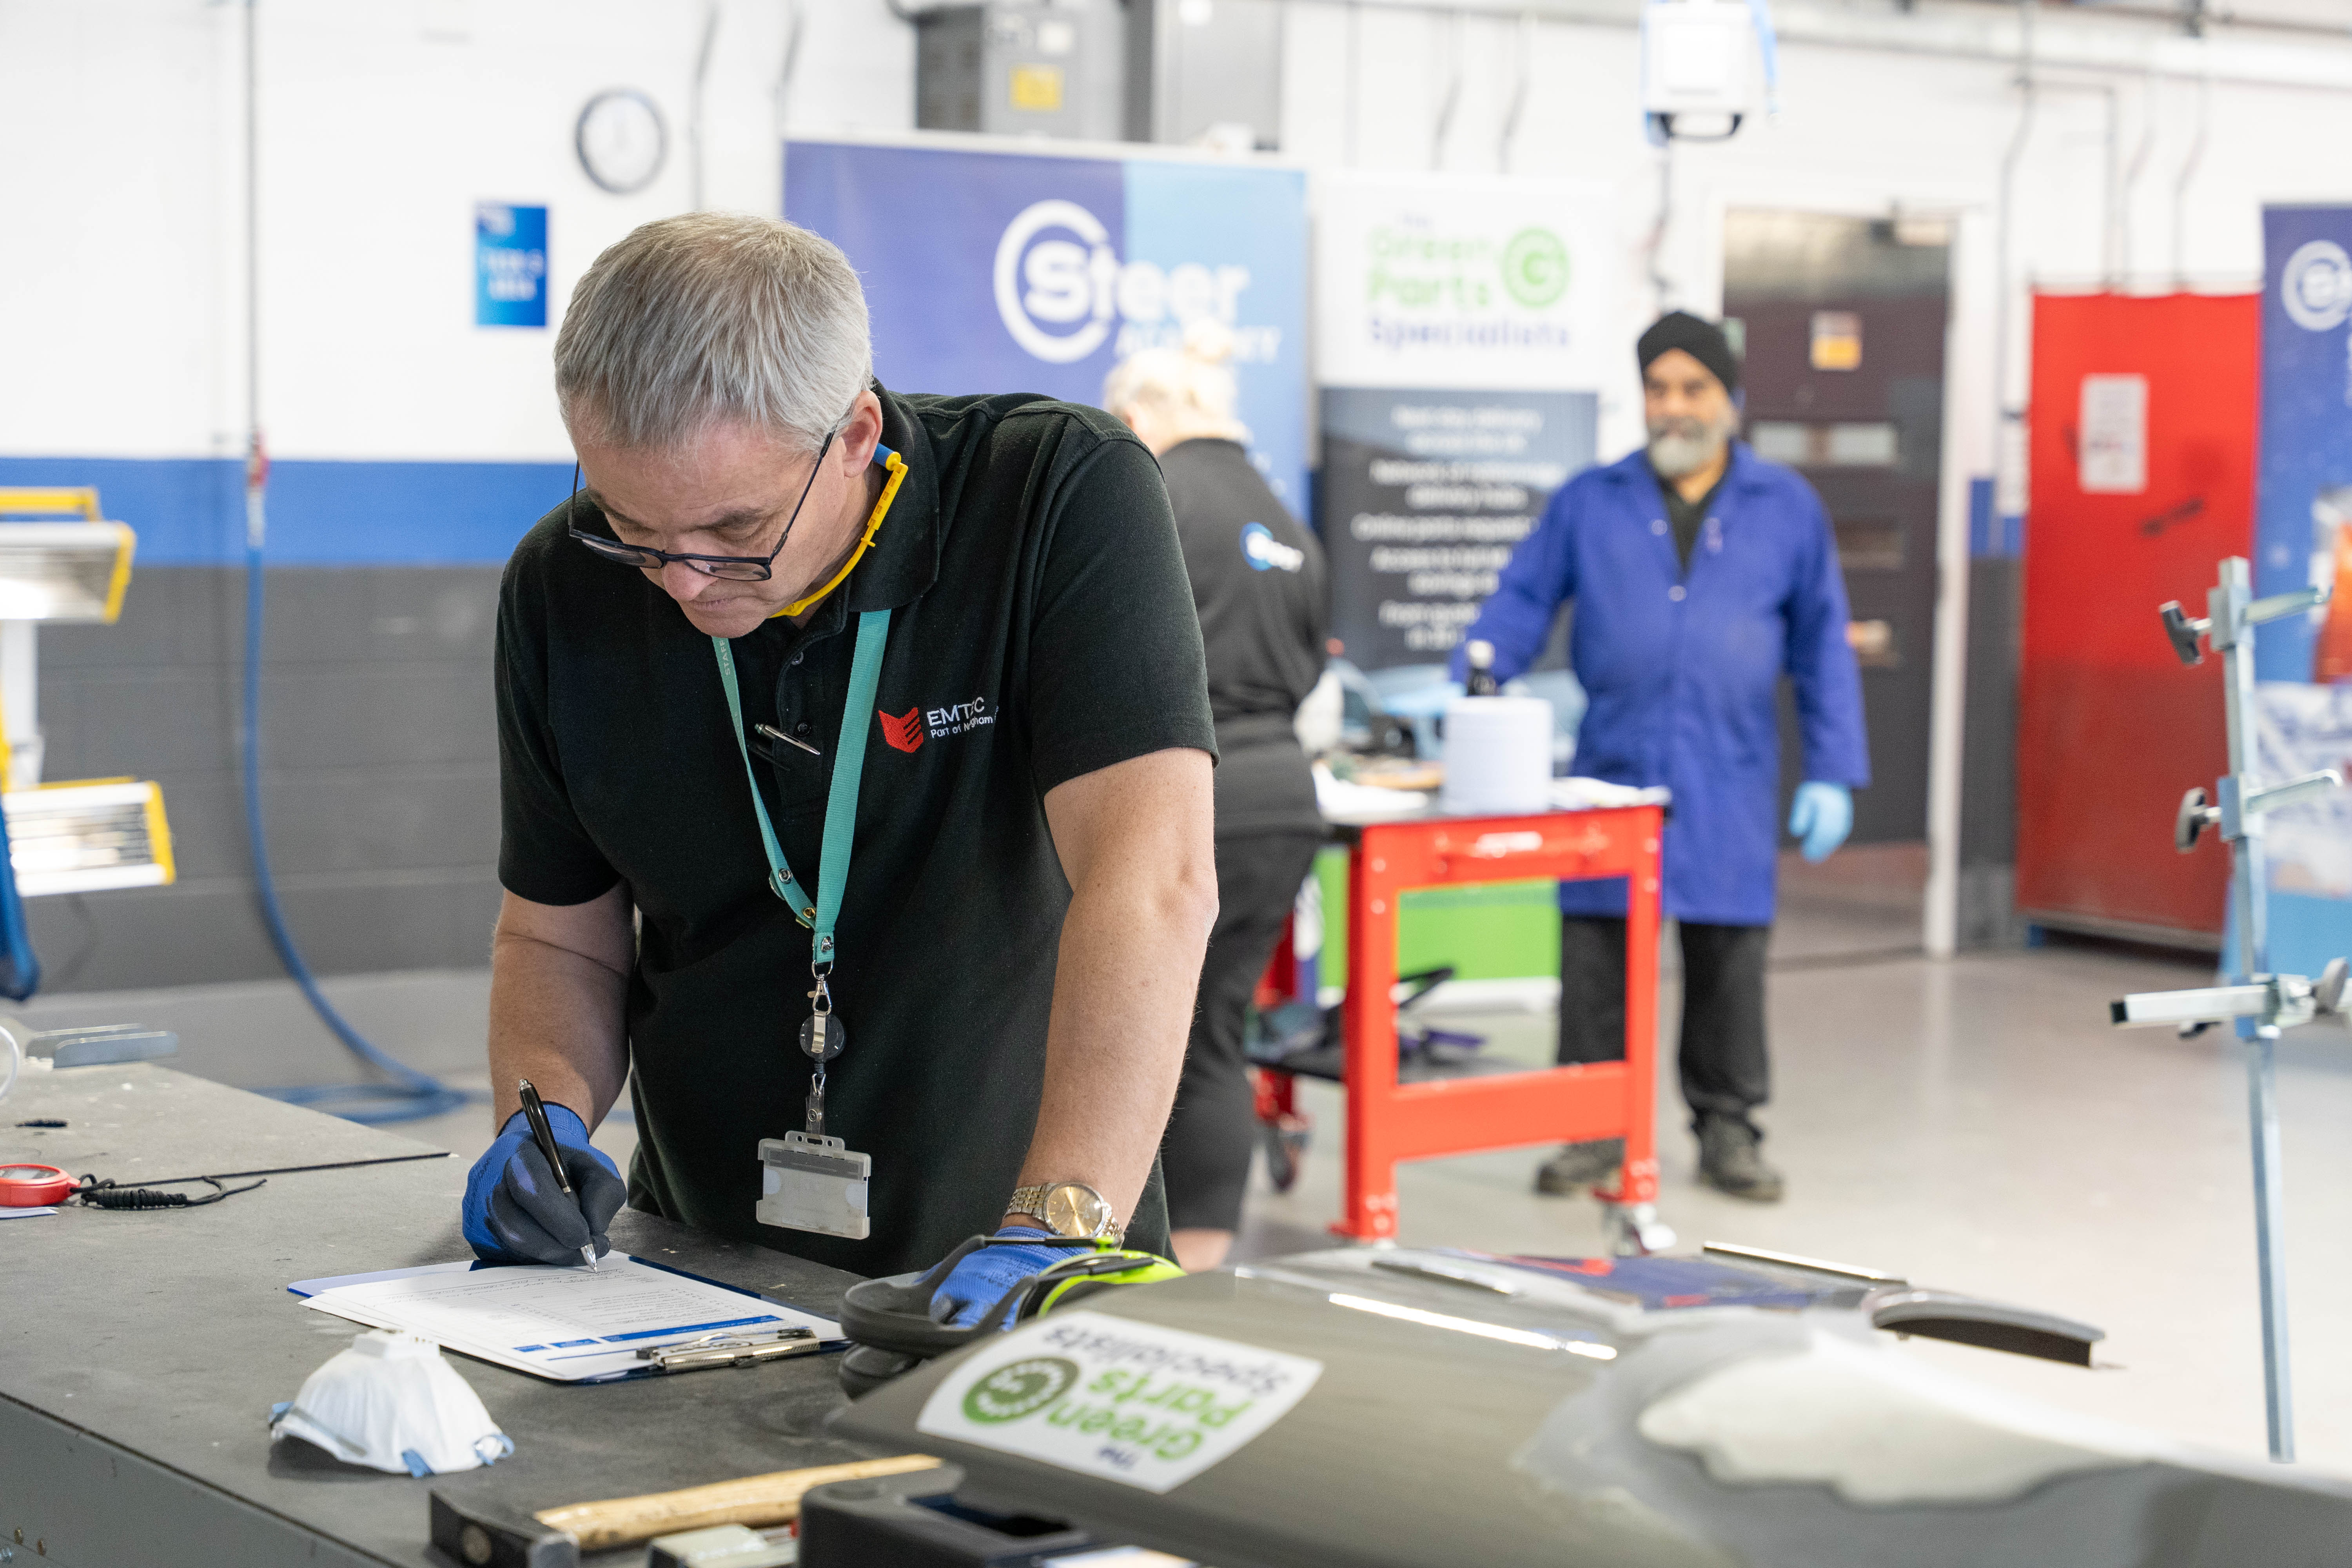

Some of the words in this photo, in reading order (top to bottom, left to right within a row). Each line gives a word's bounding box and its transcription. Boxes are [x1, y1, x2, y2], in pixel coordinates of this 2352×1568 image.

[927, 697, 985, 726] EMTC
[931, 727, 949, 739] Part
[952, 724, 962, 733] of
[1044, 1327, 1290, 1396] Specialists
[1087, 1369, 1252, 1430] Parts
[1045, 1403, 1203, 1462] Green
